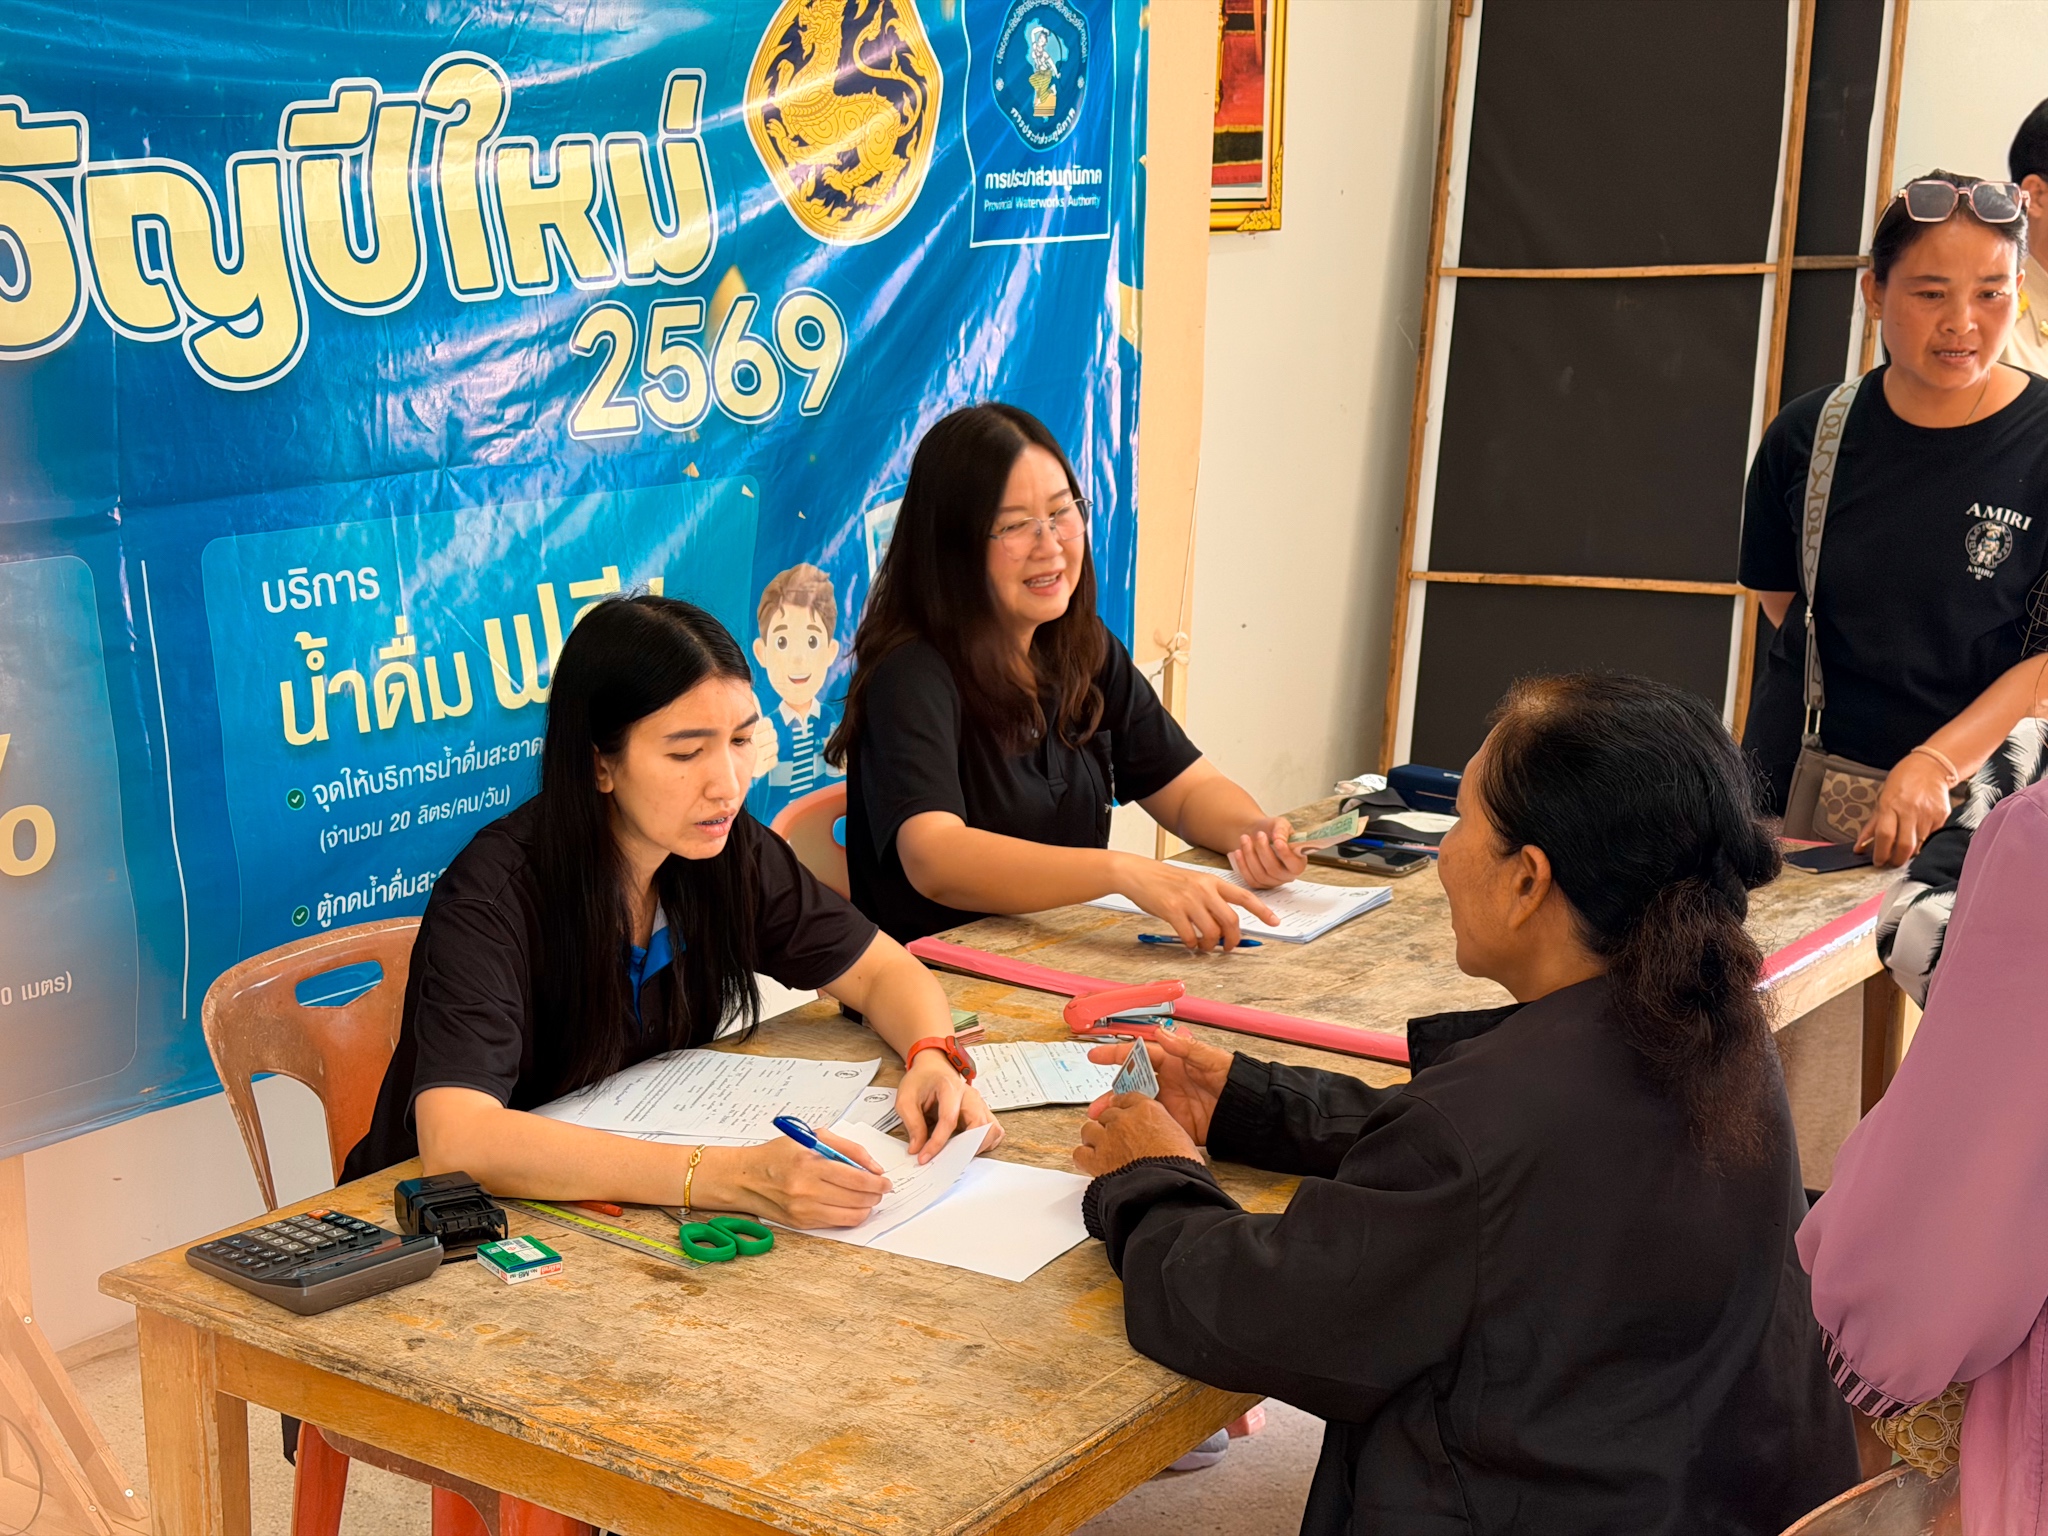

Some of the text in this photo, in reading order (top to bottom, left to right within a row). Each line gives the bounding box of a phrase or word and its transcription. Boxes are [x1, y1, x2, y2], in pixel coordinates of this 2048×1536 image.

[985, 164, 1102, 192] การประปาส่วนภูมิภาค
[1015, 194, 1065, 209] Waterworks
[1067, 193, 1101, 209] Authority
[568, 287, 848, 441] 2569
[1965, 502, 2033, 532] AMIRI
[262, 566, 380, 614] บริการ
[279, 615, 475, 746] น้ำดื่ม
[319, 784, 511, 853] (จำนวน 20 ลิตร/คน/วัน)
[21, 970, 73, 1001] เมตร)
